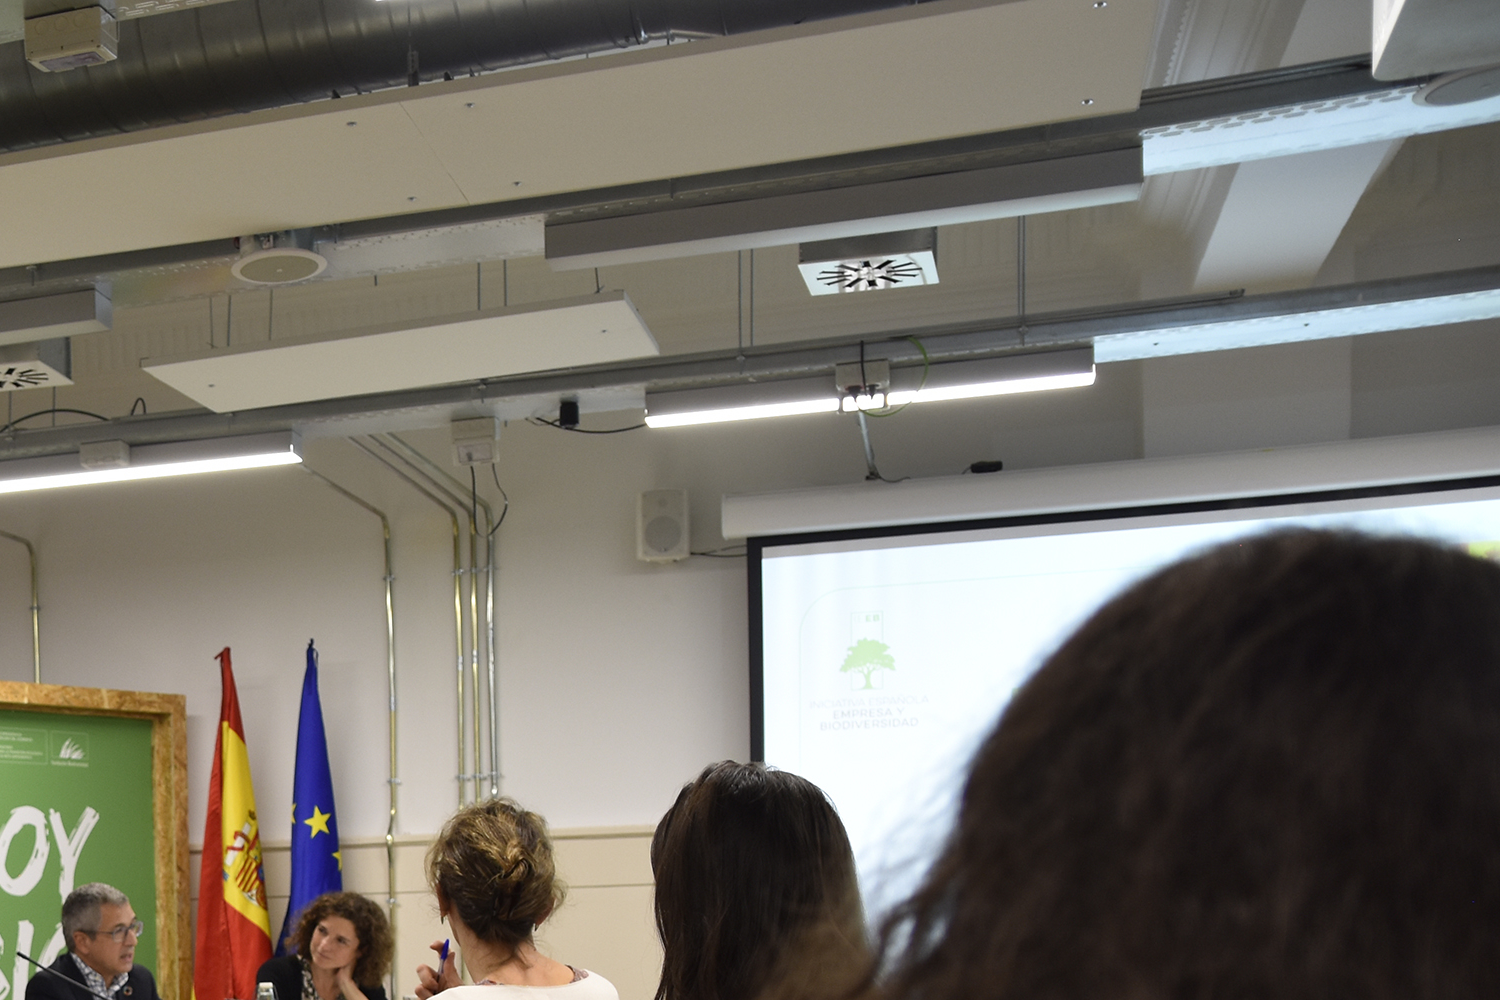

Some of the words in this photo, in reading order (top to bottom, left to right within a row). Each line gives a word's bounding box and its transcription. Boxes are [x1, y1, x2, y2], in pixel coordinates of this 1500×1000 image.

[809, 698, 865, 709] INICIATIVA
[868, 694, 929, 706] ESPAÑOLA
[833, 708, 893, 720] EMPRESA
[896, 707, 905, 716] Y
[820, 717, 919, 731] BIODIVERSIDAD
